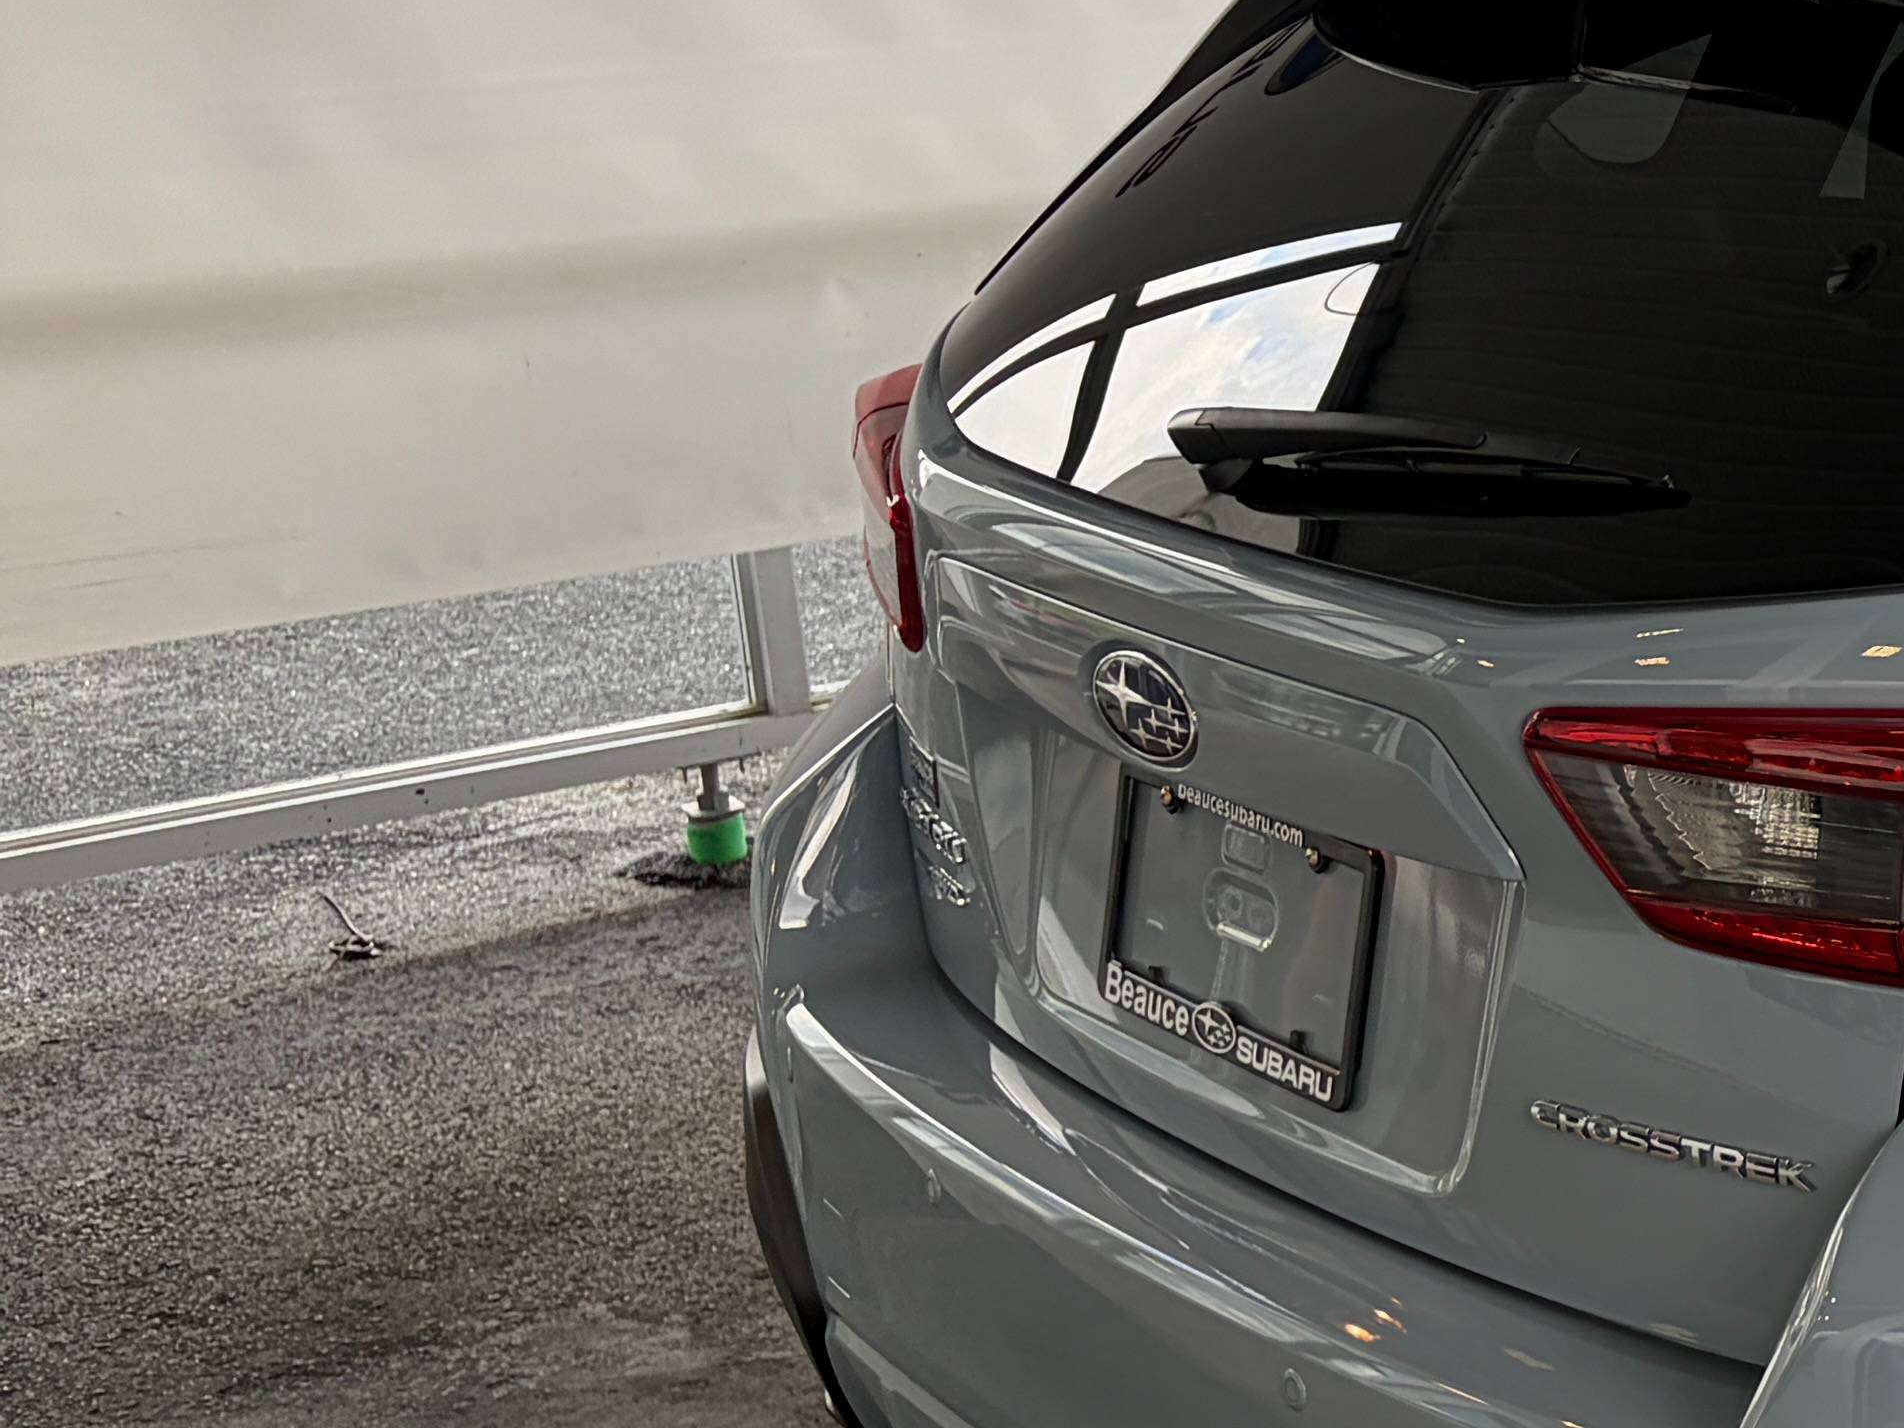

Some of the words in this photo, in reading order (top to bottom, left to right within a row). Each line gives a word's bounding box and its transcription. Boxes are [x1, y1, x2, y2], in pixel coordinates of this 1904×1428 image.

[1105, 962, 1190, 1037] Beauce
[1236, 1035, 1334, 1103] SUBARU
[1530, 1099, 1817, 1193] CROSSTREK
